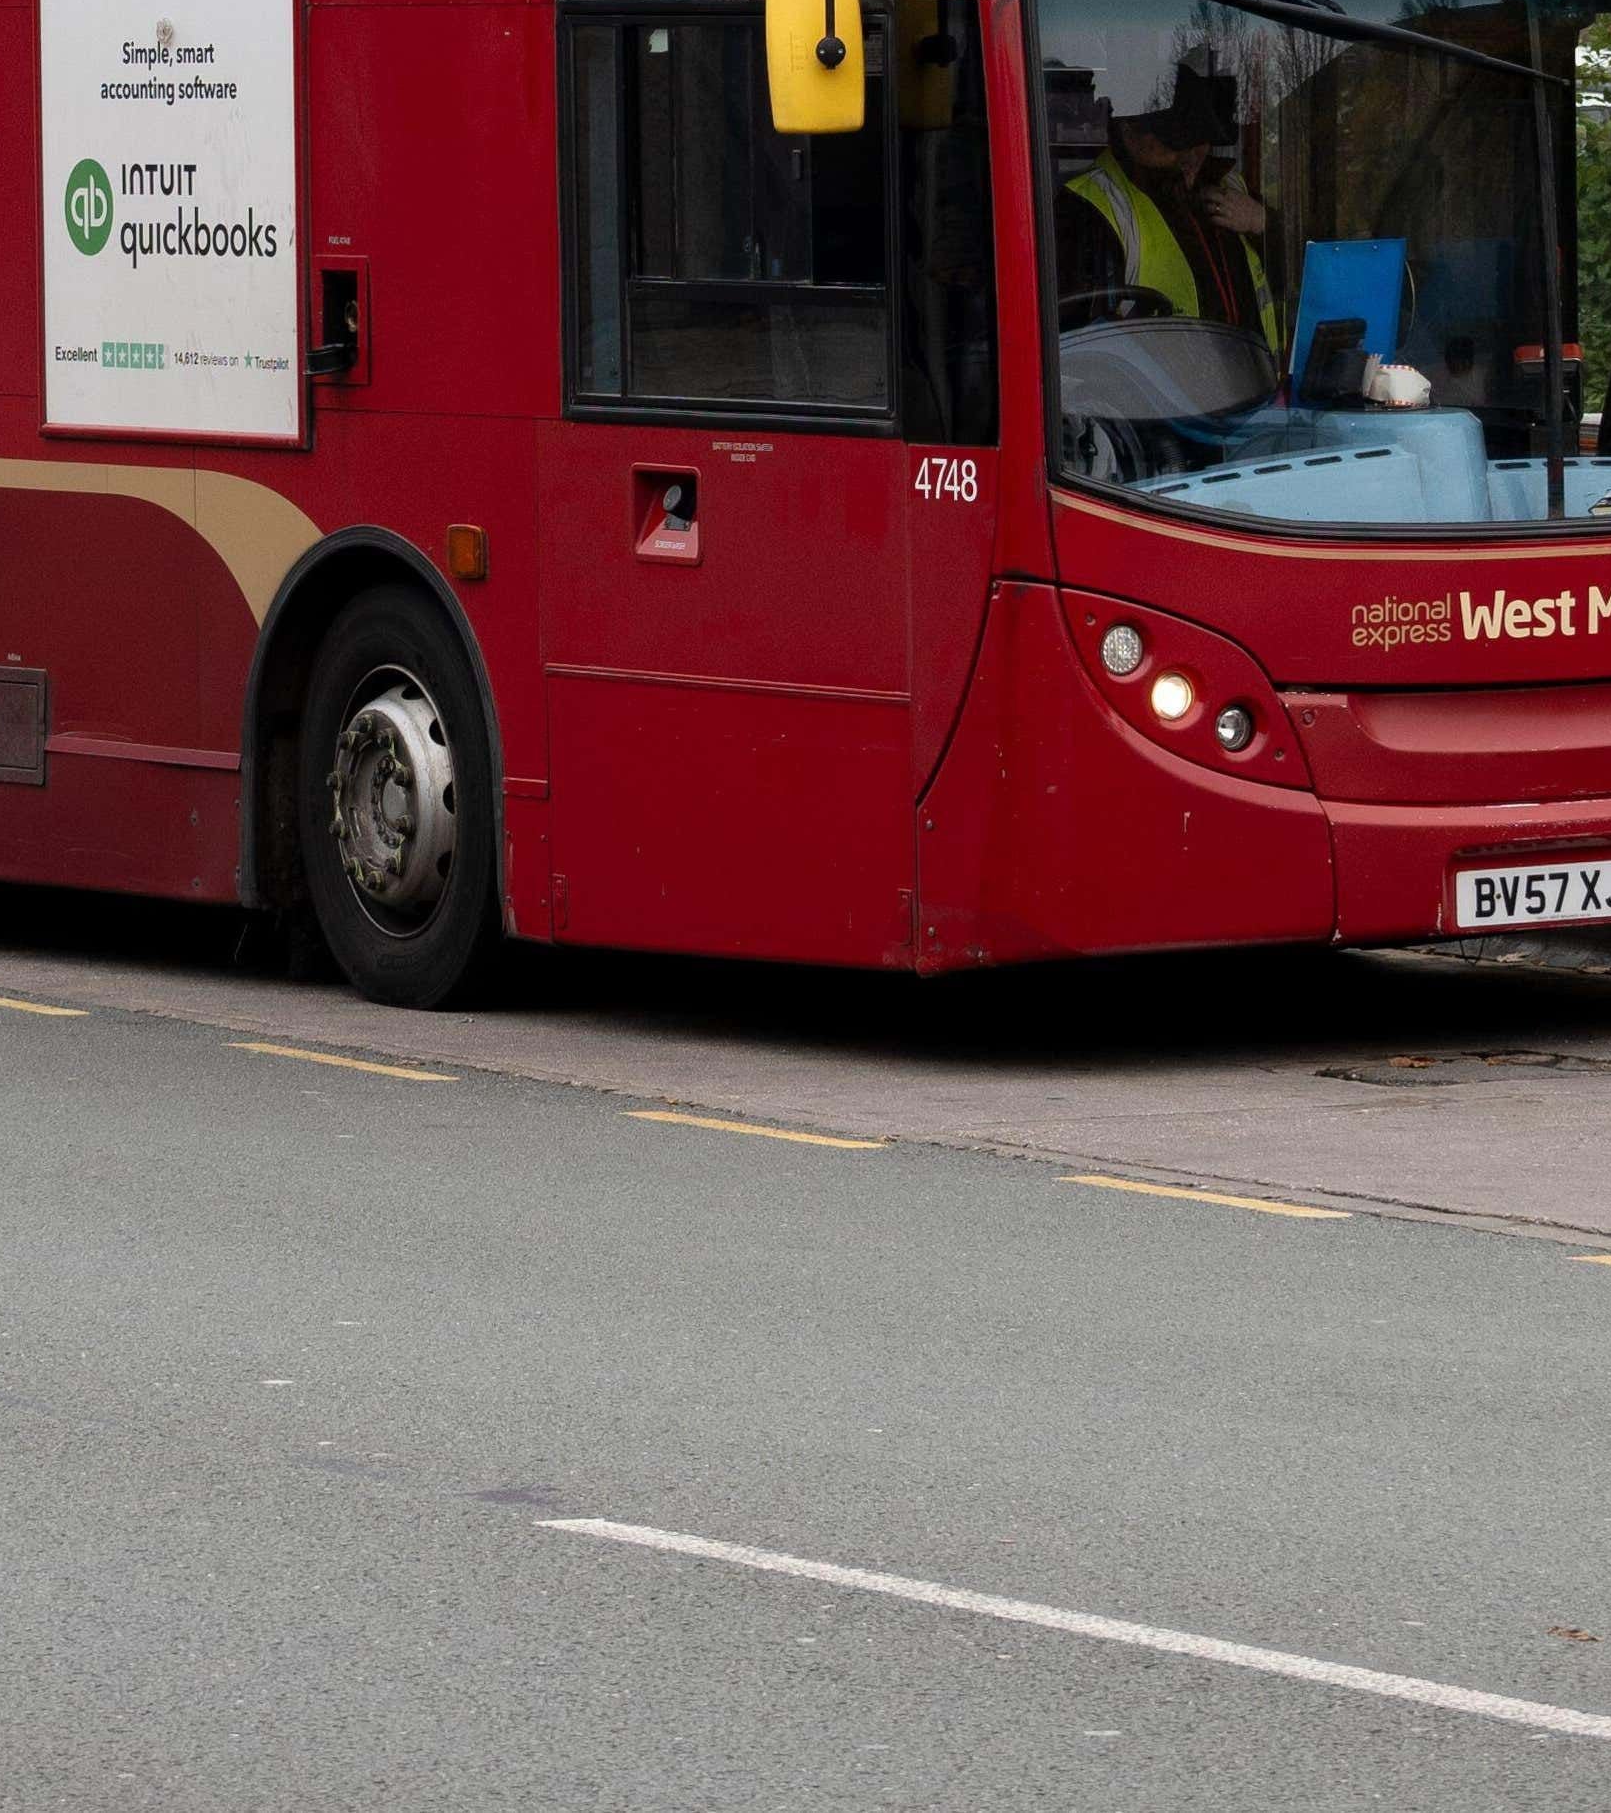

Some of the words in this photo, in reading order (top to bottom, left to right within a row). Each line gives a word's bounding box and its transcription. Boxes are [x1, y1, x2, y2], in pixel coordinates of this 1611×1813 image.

[122, 42, 173, 70] Simple,
[176, 43, 215, 64] smart
[100, 76, 175, 106] accounting
[178, 75, 238, 99] software
[120, 206, 278, 269] quickbooks
[54, 345, 98, 363] Excellent
[200, 354, 229, 367] reviews
[255, 356, 290, 372] Trustpilot
[914, 457, 978, 502] 4748
[1352, 593, 1452, 625] national
[1459, 590, 1576, 640] West
[1352, 620, 1452, 652] express
[1474, 872, 1569, 918] BV57
